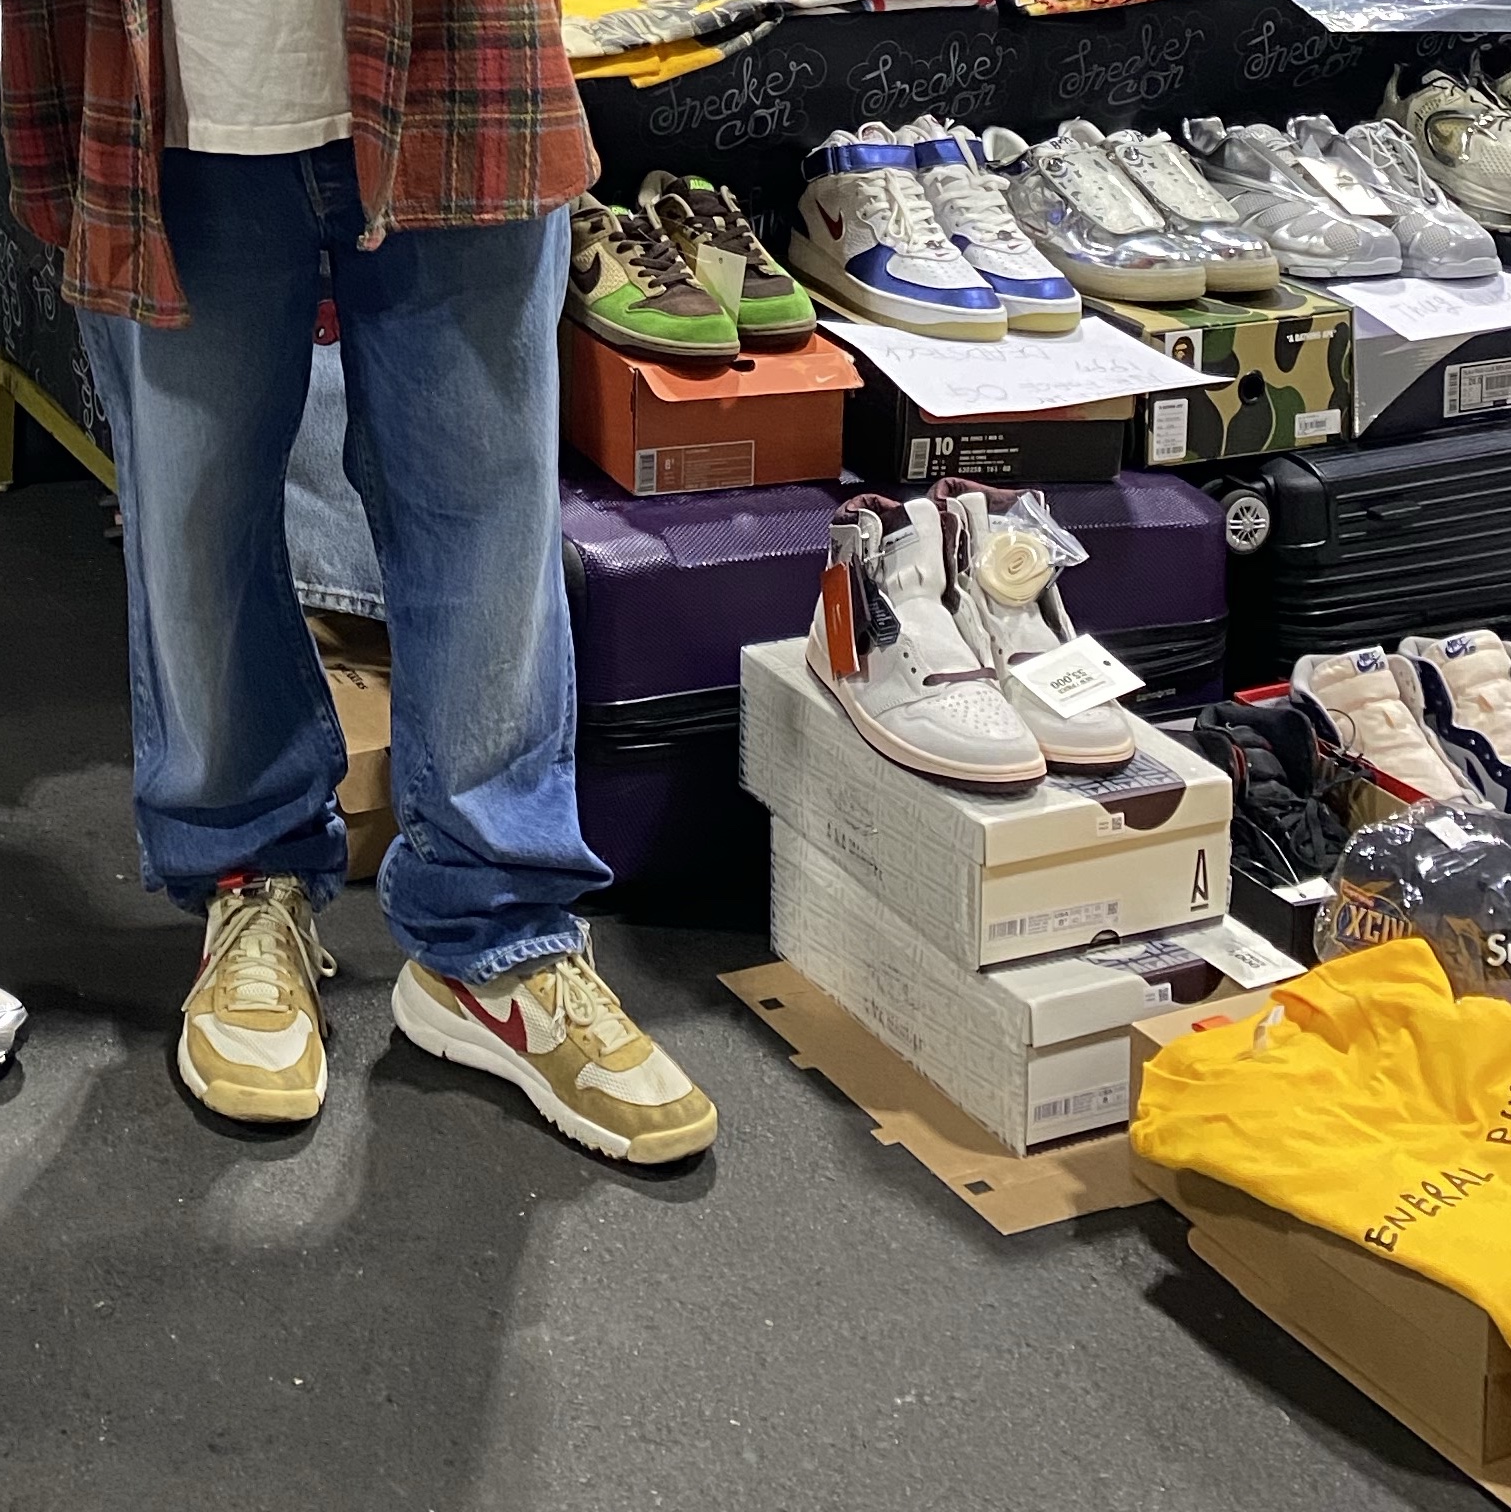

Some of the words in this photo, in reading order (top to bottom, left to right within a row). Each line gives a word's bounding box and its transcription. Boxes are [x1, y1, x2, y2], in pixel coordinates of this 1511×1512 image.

[935, 436, 954, 456] 10
[1486, 933, 1511, 967] S
[1364, 1167, 1495, 1253] ENERAL
